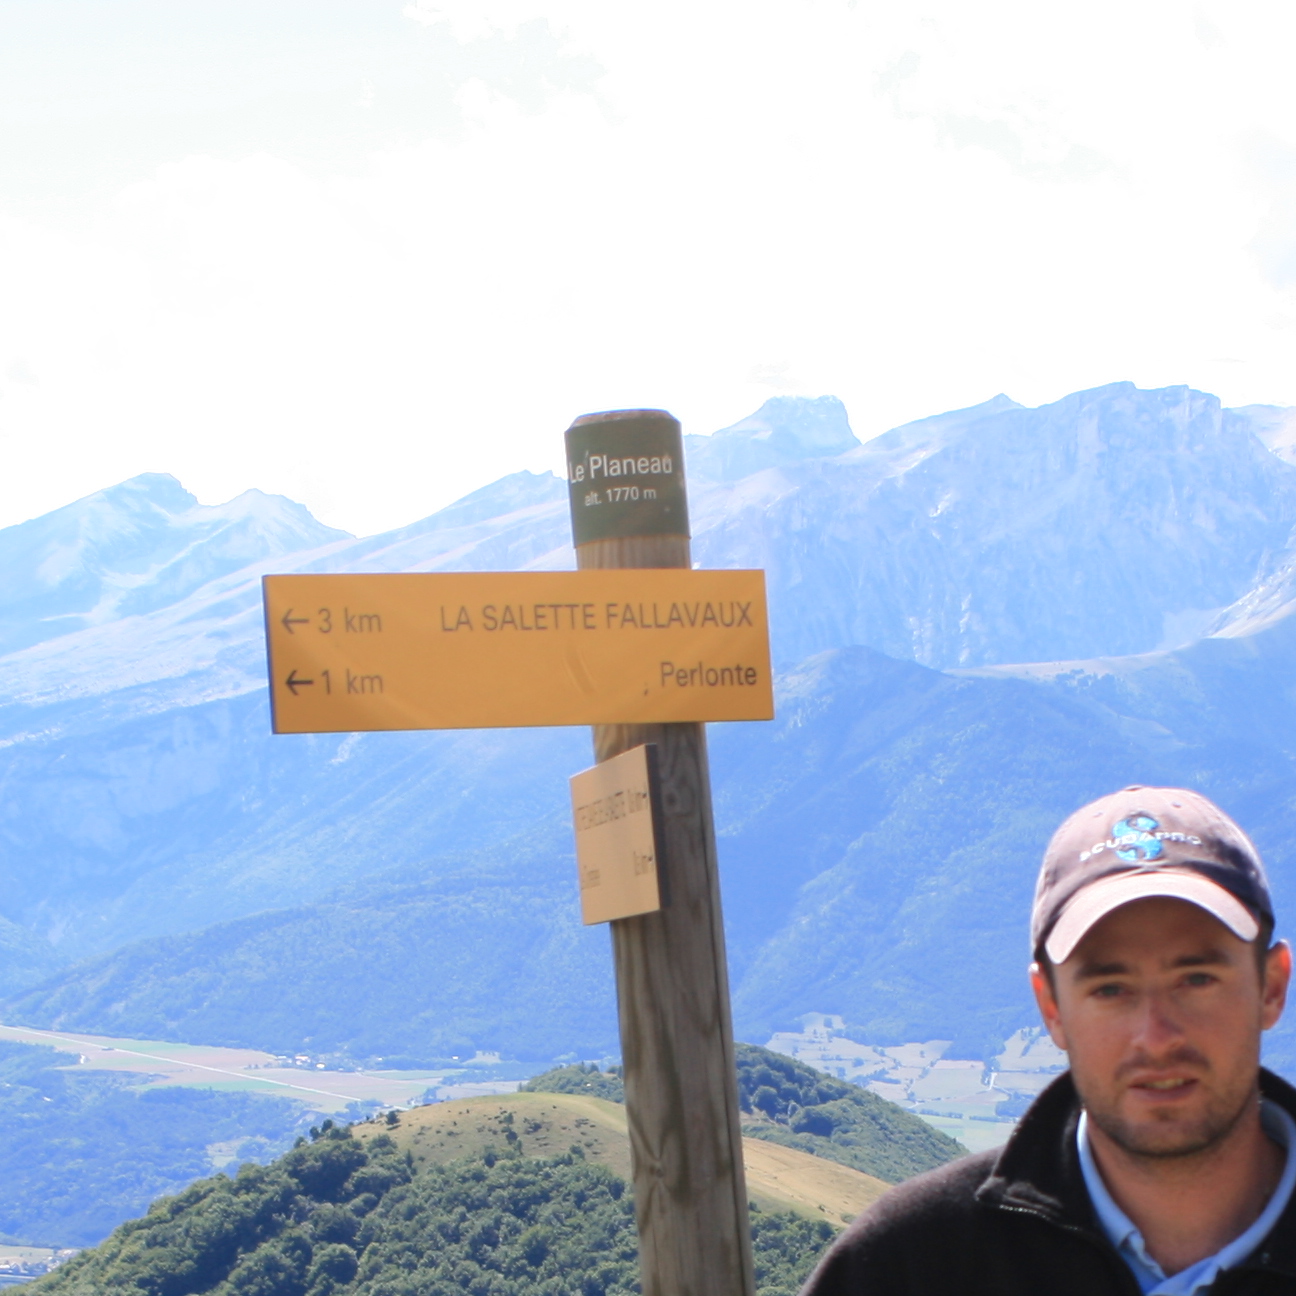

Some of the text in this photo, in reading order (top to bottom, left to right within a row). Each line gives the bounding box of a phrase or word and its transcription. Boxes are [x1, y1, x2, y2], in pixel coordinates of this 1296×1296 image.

[568, 454, 673, 484] Le Planeau
[584, 486, 657, 507] alt. 1770 m
[317, 601, 753, 634] 3 km LA SALETTE FALLAVAUX
[320, 660, 758, 695] 1 km Perlonte
